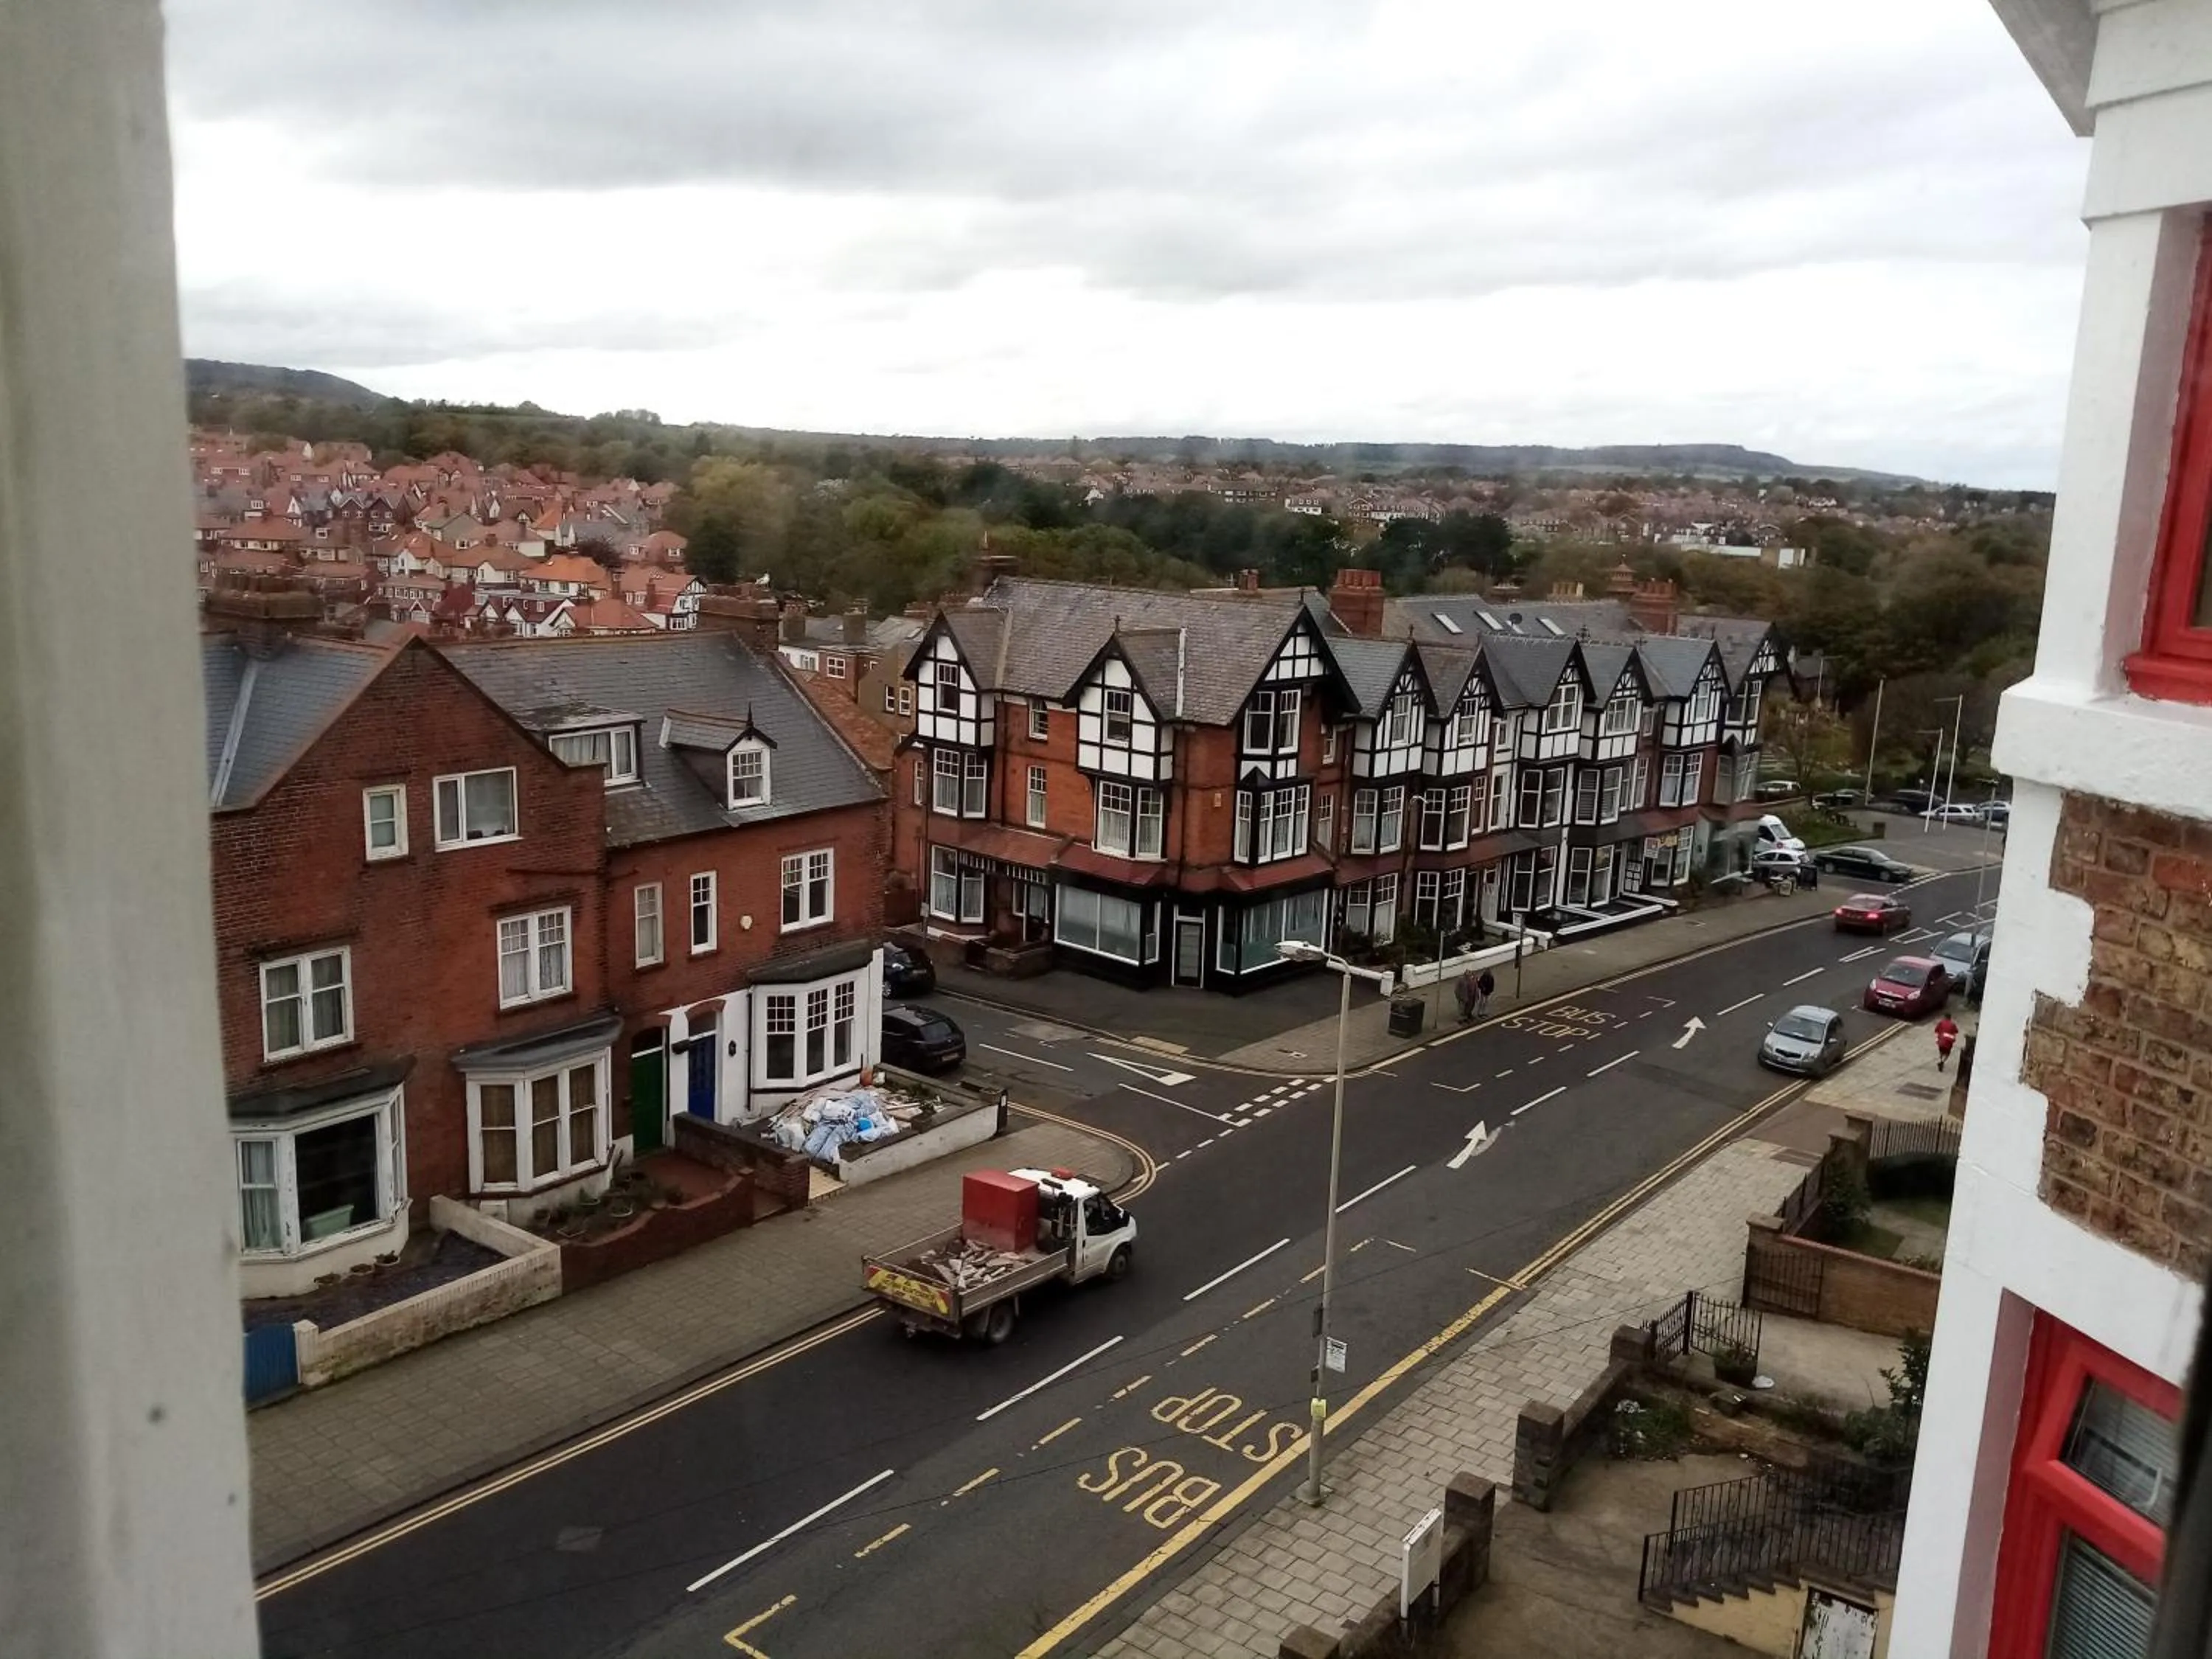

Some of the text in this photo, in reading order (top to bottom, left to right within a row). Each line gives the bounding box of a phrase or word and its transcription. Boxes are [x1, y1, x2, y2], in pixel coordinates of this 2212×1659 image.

[1500, 1017, 1590, 1038] STOP
[1545, 1005, 1616, 1024] BUS
[1150, 1387, 1303, 1462] STOP
[1077, 1447, 1222, 1528] BUS
